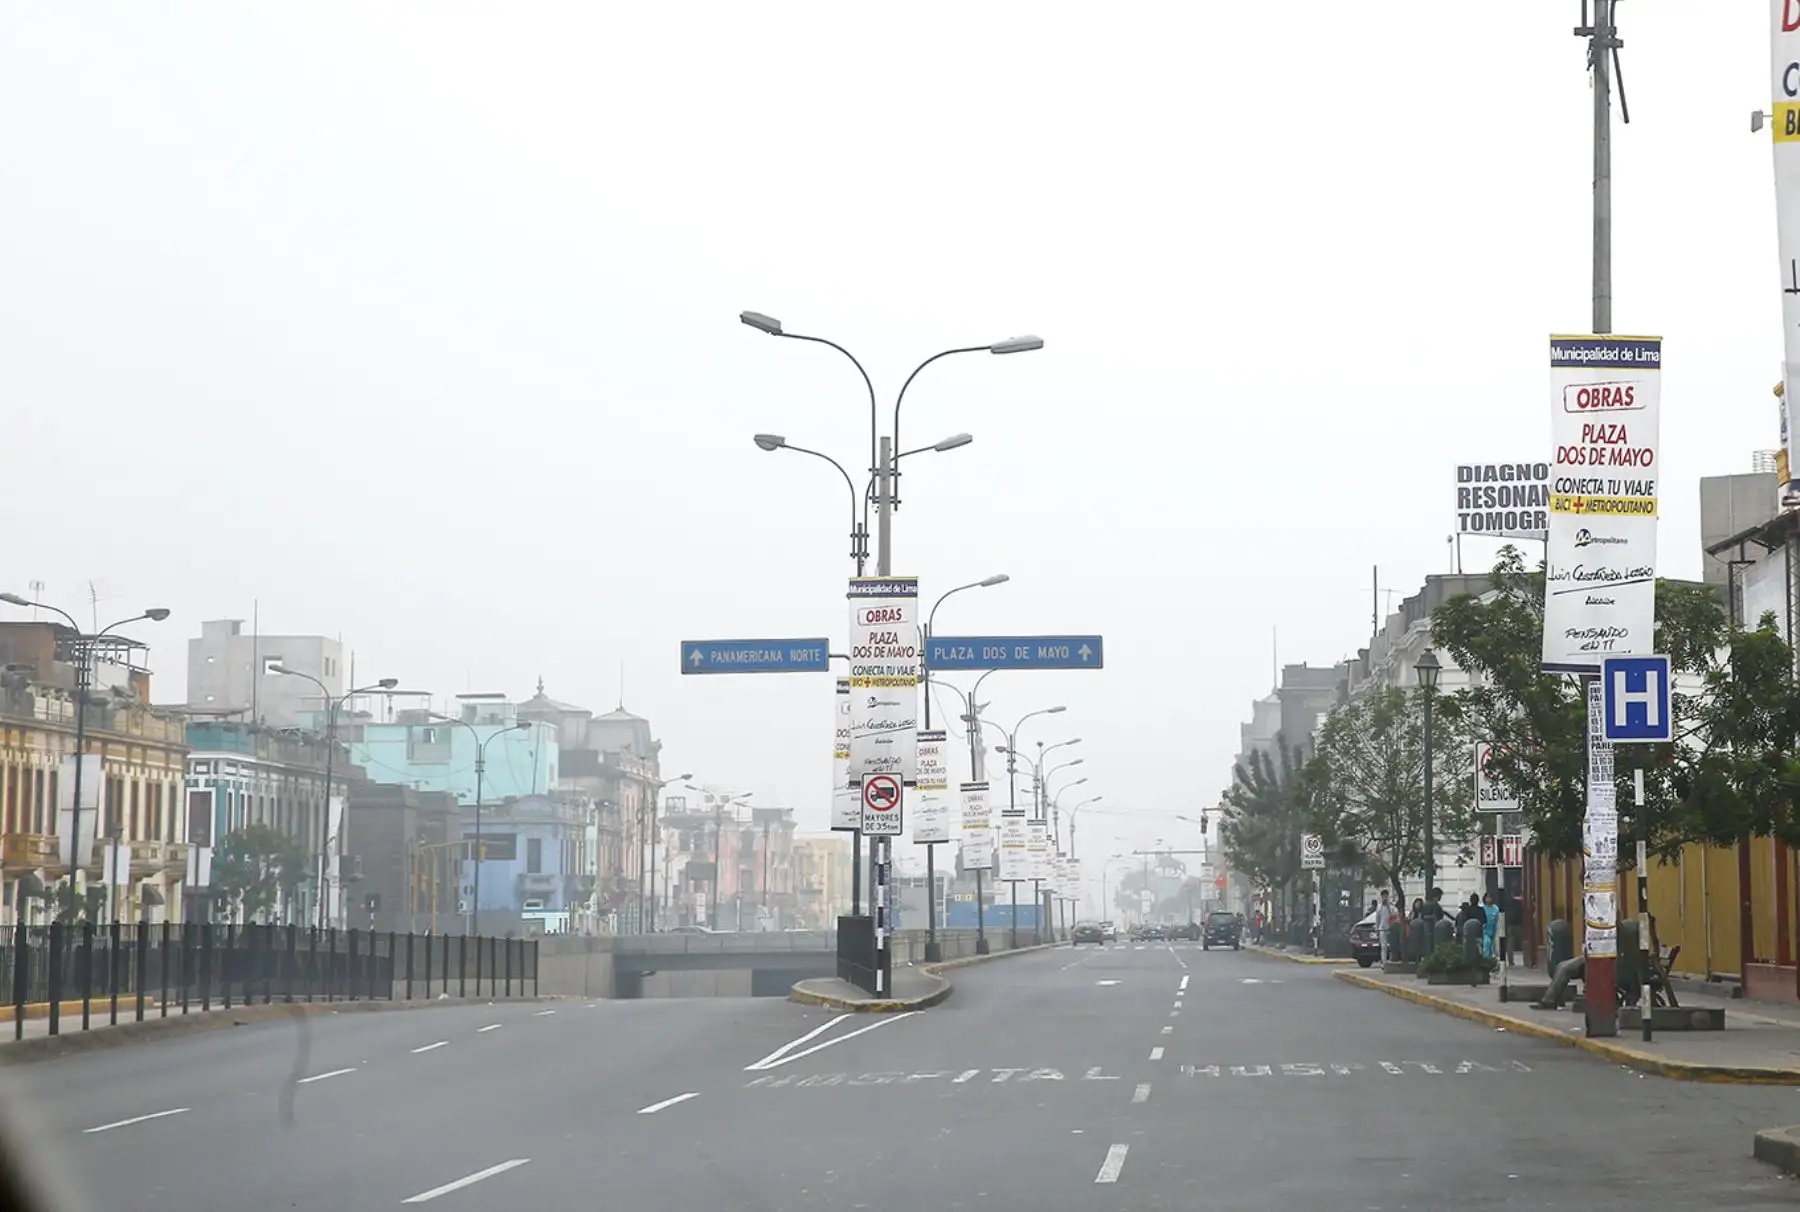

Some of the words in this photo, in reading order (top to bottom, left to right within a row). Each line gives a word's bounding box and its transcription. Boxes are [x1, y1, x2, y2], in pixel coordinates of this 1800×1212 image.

[1551, 346, 1619, 363] Municipalidad
[1620, 347, 1633, 361] de
[1635, 348, 1660, 361] Lima
[1577, 386, 1634, 408] OBRAS
[1582, 424, 1627, 444] PLAZA
[1557, 446, 1586, 465] DOS
[1589, 447, 1606, 466] DE
[1608, 448, 1654, 467] MAYO
[1457, 463, 1552, 483] DIAGNO
[1555, 477, 1604, 494] CONECTA
[1607, 479, 1621, 494] TU
[1623, 480, 1654, 496] VIAJE
[1586, 500, 1654, 513] METROPOLITANO
[1457, 510, 1550, 532] TOMOGR
[866, 608, 902, 623] OBRAS
[868, 631, 899, 645] PLAZA
[711, 650, 783, 663] PANAMERICANA
[790, 649, 821, 661] NORTE
[852, 646, 872, 659] DOS
[874, 646, 885, 658] DE
[886, 646, 915, 659] MAYO
[934, 648, 974, 660] PLAZA
[983, 647, 1007, 659] DOS
[1015, 647, 1030, 659] DE
[1038, 646, 1070, 659] MAYO
[852, 665, 885, 676] CONECTA
[886, 665, 895, 676] TU
[896, 666, 916, 676] VIAJE
[1614, 670, 1660, 727] H
[1480, 787, 1517, 801] SILENC
[1307, 839, 1319, 849] 60
